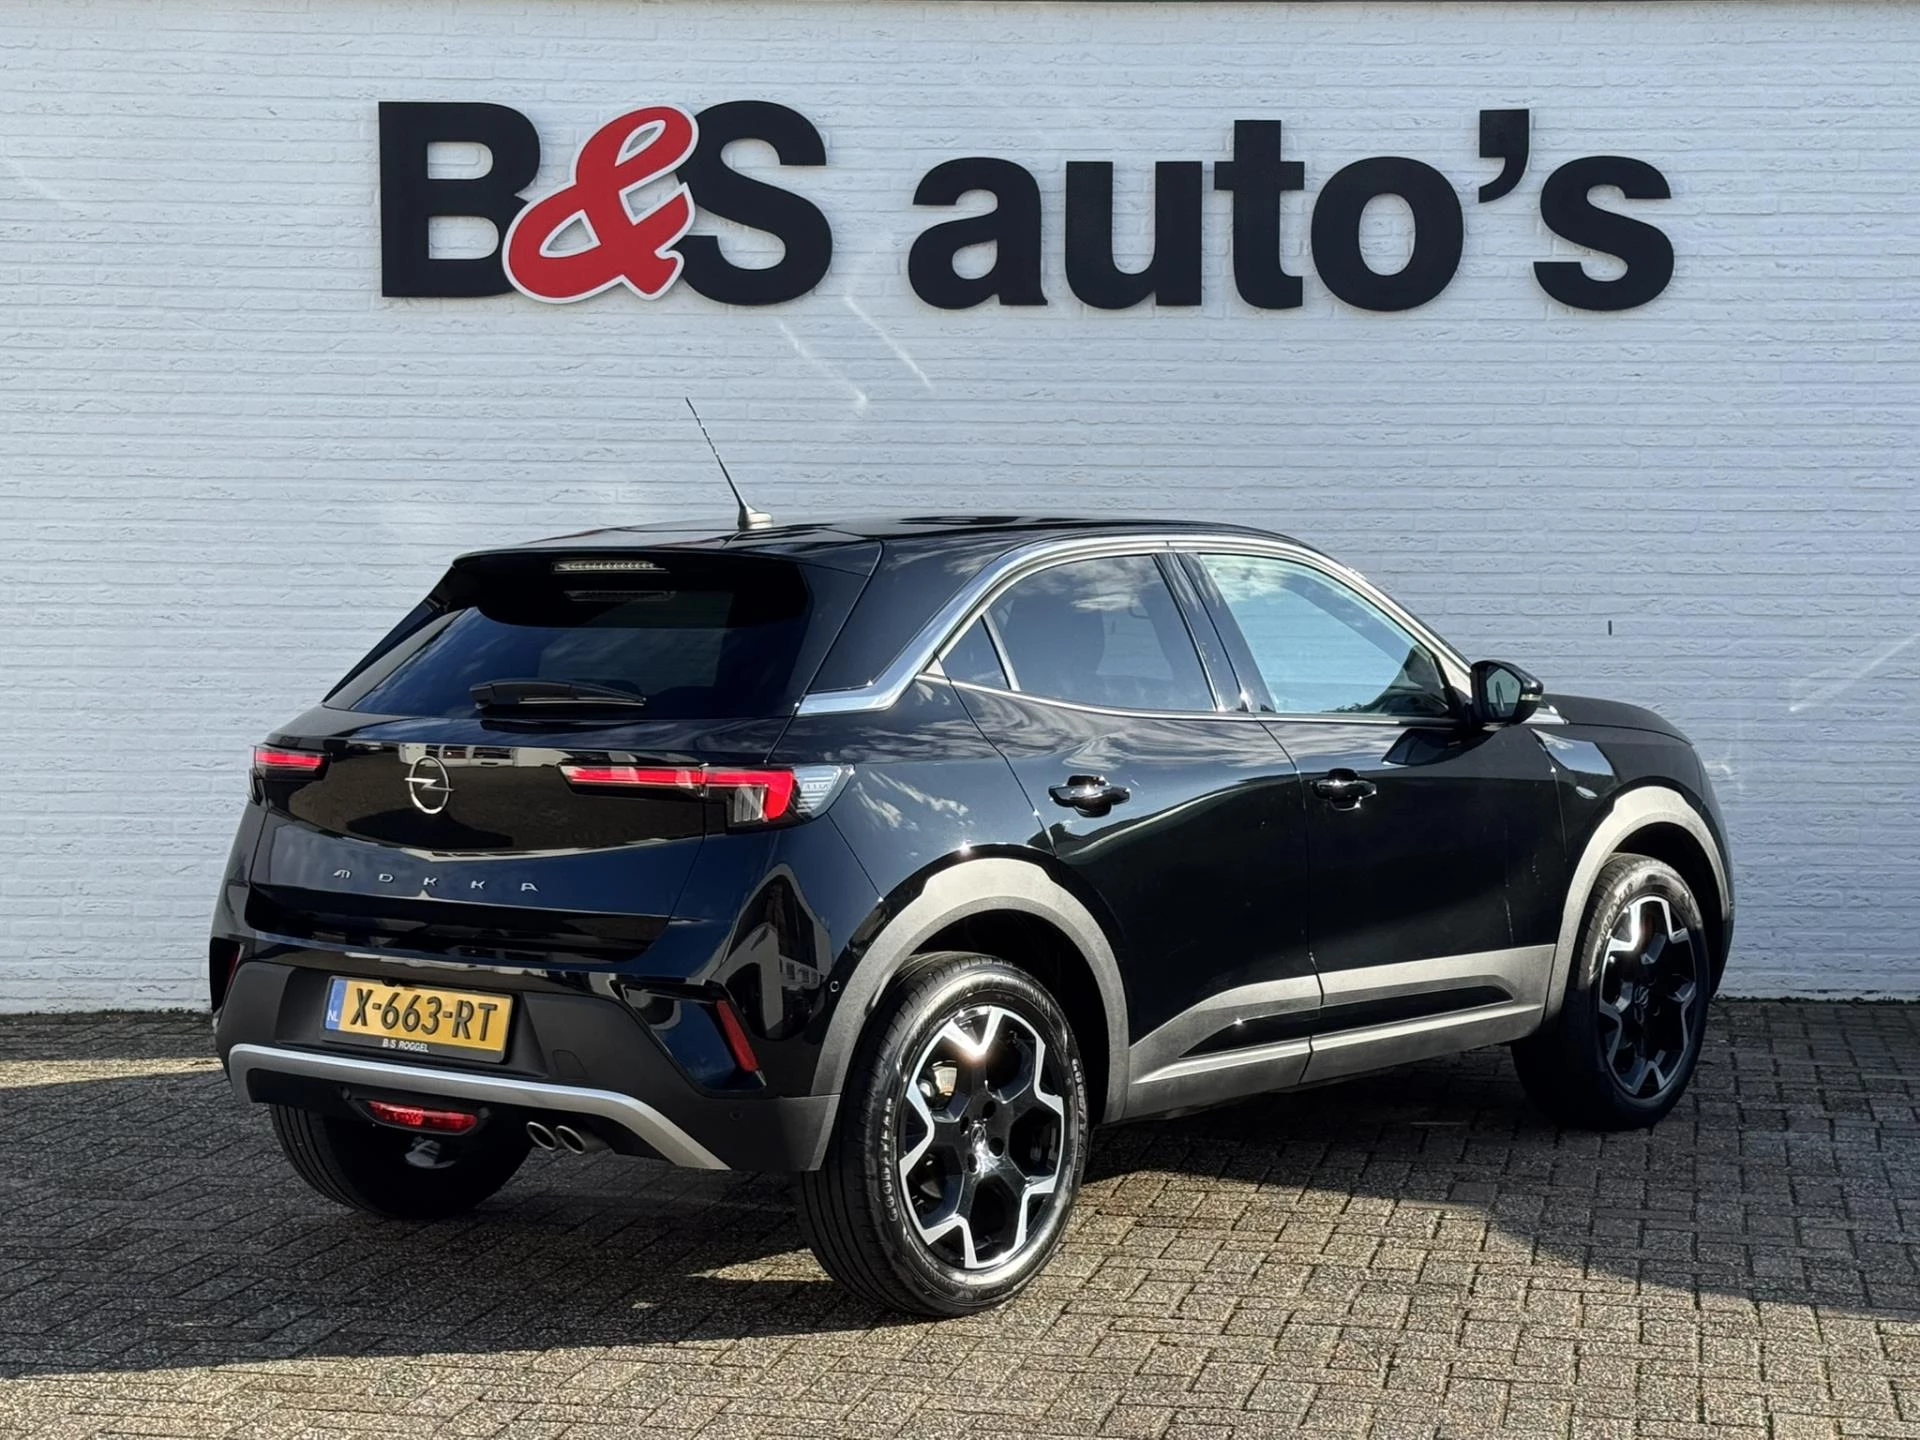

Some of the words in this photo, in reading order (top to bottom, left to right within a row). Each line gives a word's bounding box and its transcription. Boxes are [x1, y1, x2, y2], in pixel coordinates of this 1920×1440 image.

[378, 100, 833, 306] B&S
[907, 108, 1676, 313] auto's
[333, 869, 539, 893] MOKKA
[326, 1010, 339, 1023] NL
[350, 987, 498, 1042] X-663-RT
[398, 1039, 430, 1053] ROGGEL
